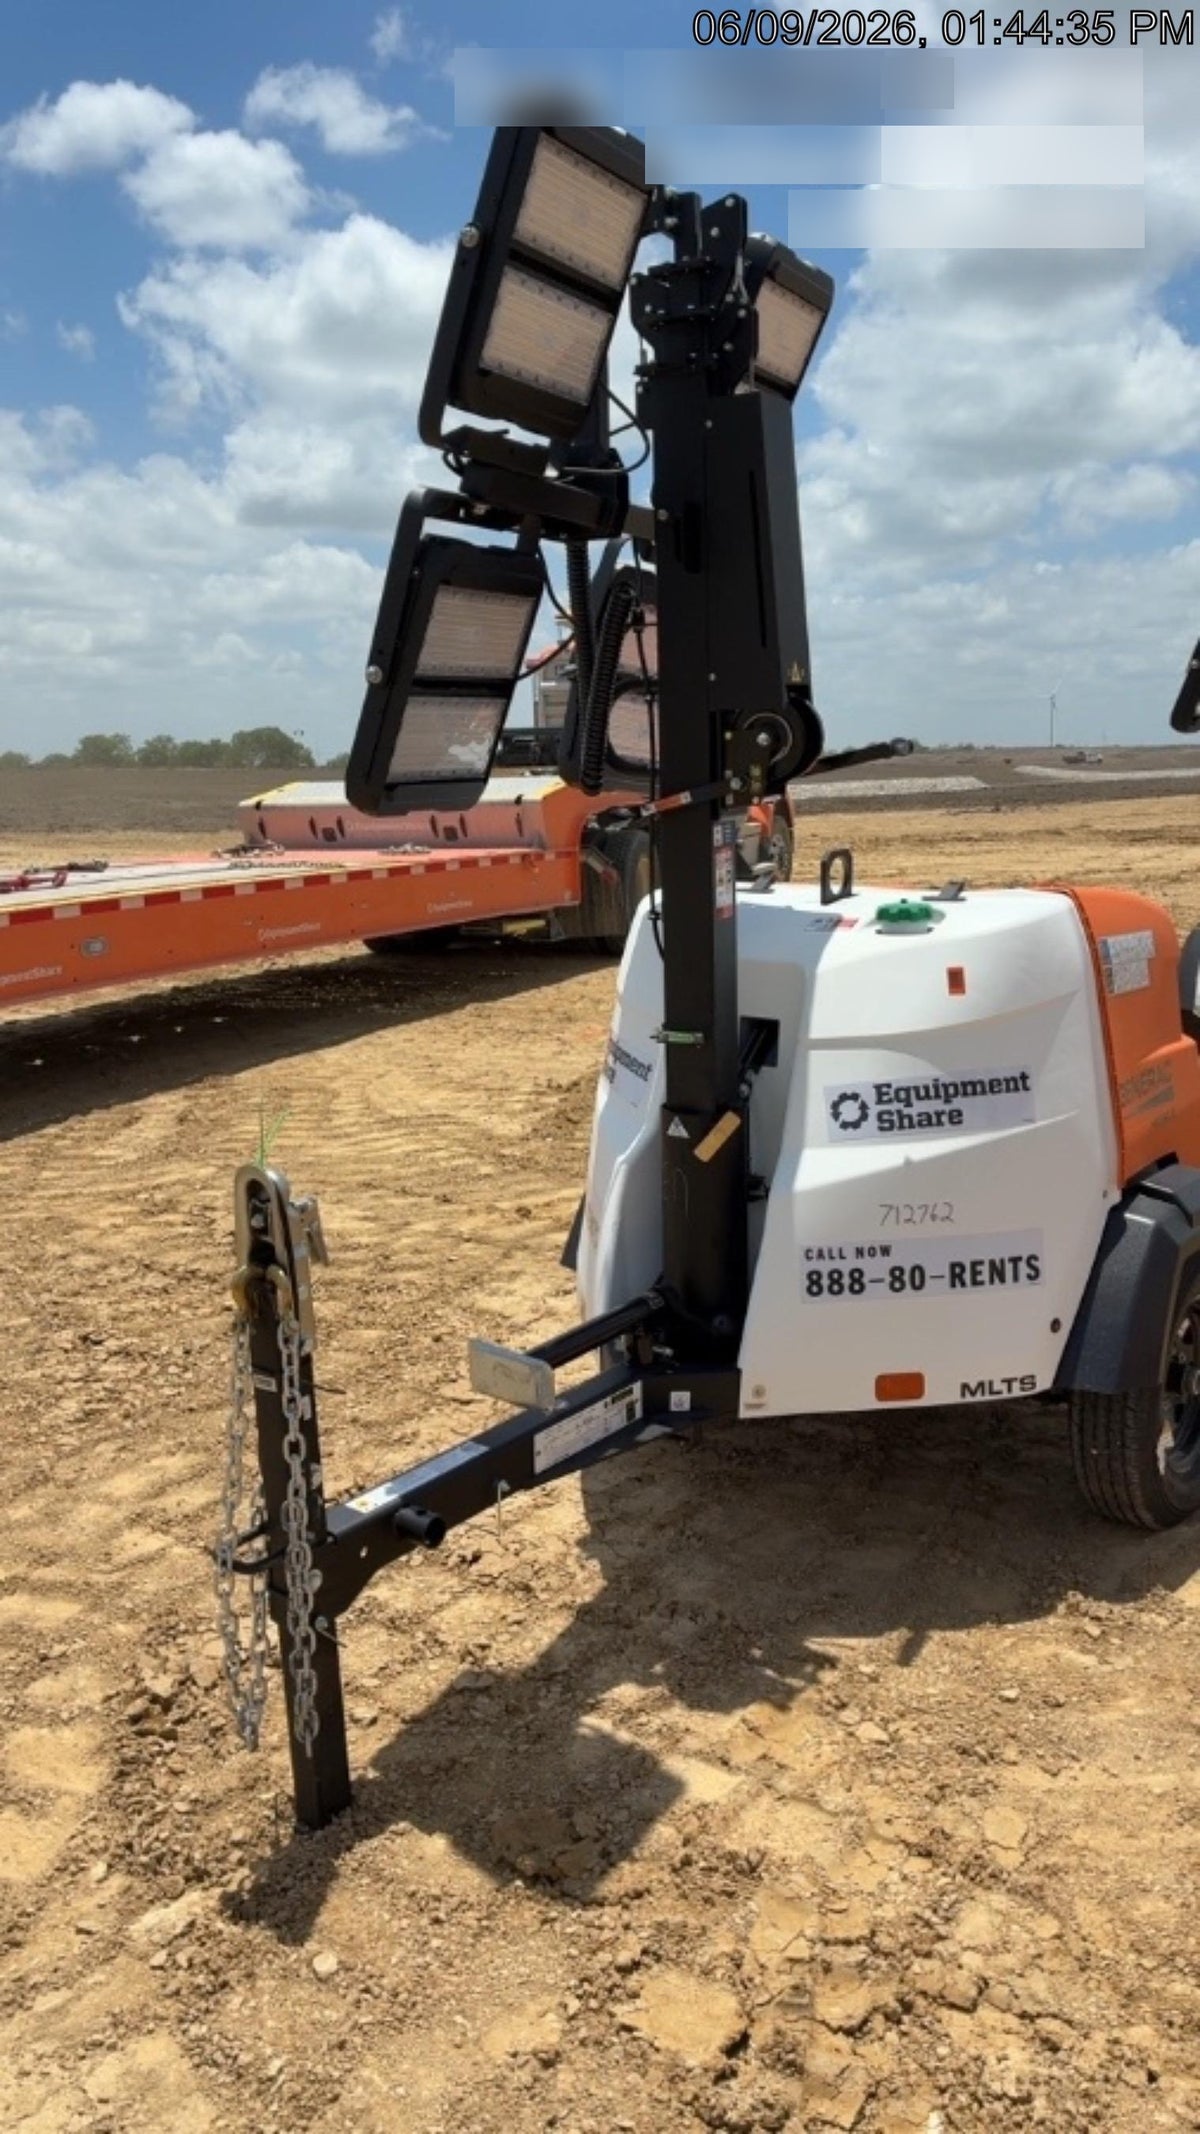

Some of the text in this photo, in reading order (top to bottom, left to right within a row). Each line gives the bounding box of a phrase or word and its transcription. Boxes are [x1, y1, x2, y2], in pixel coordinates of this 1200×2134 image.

[873, 1070, 1031, 1108] Equipment
[877, 1108, 963, 1132] Share
[879, 1202, 954, 1226] 712762
[804, 1244, 892, 1262] CALL NOW
[806, 1254, 1040, 1297] 888-80-RENTS
